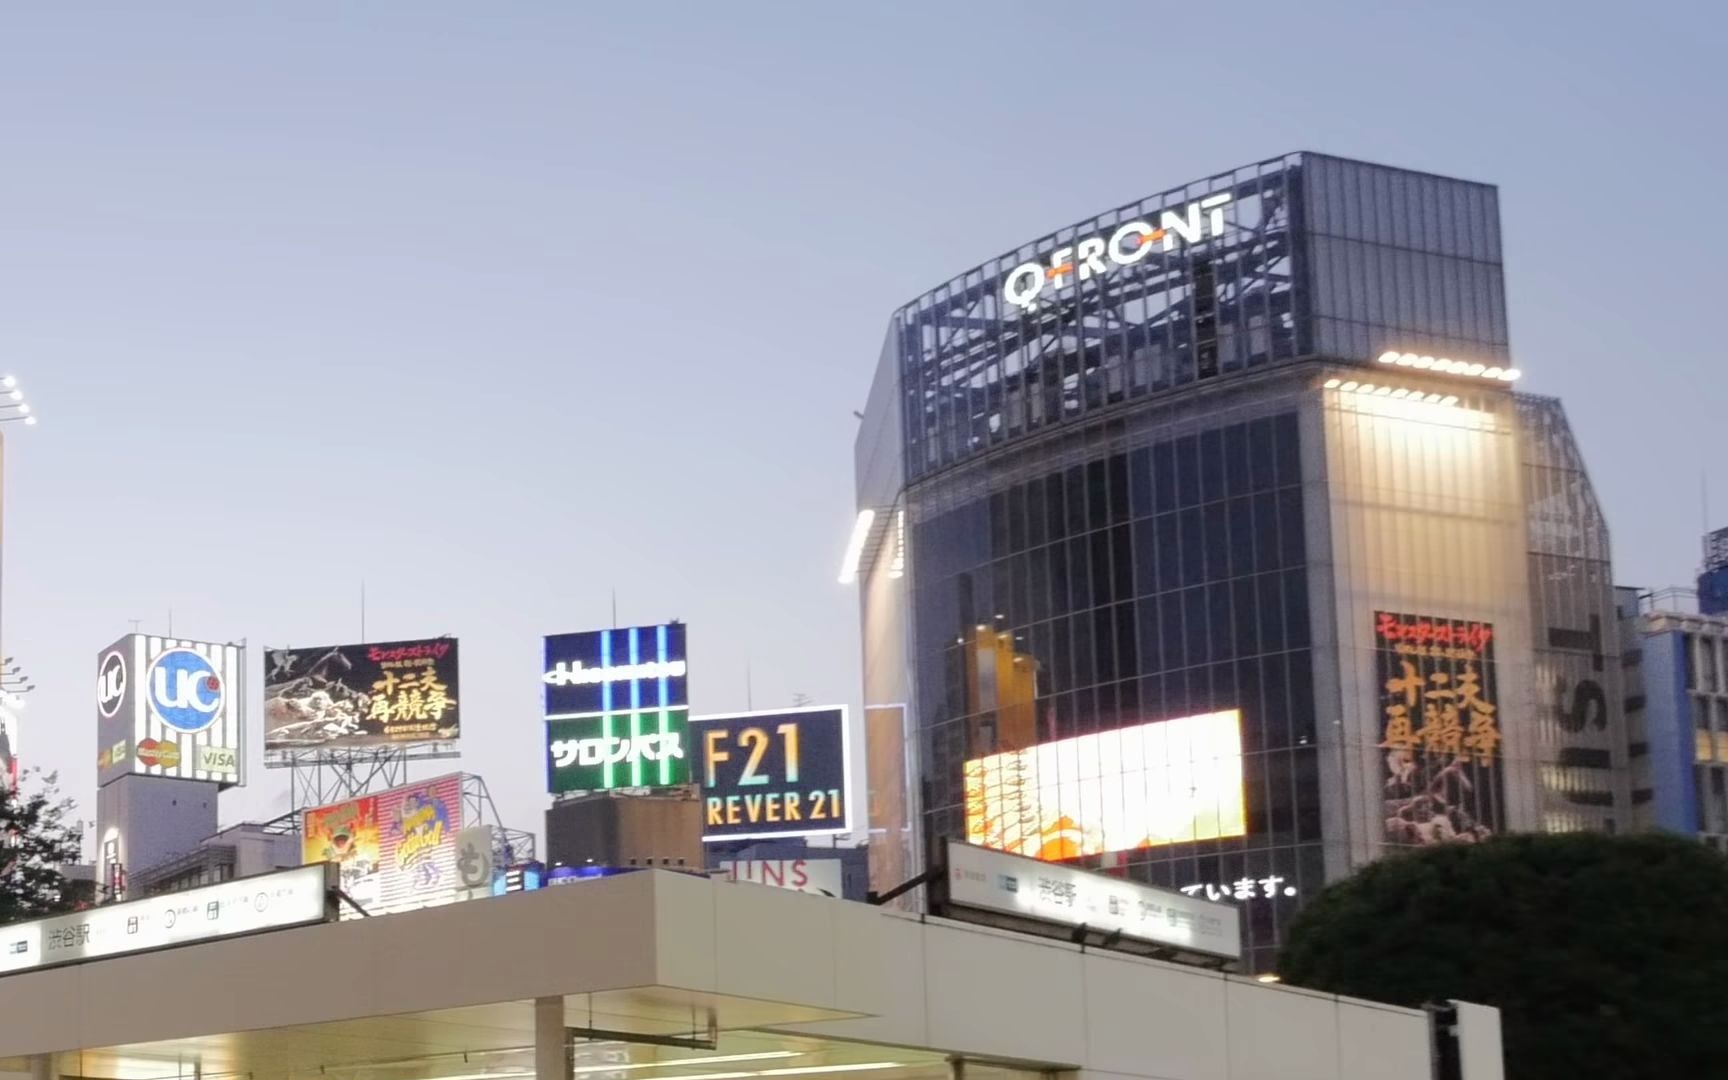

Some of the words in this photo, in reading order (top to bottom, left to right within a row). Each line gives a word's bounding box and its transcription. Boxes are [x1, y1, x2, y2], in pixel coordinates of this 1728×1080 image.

[1004, 193, 1232, 312] QFRONT
[203, 753, 236, 767] VISA
[705, 723, 800, 788] F21
[808, 789, 841, 820] 21
[47, 924, 90, 951] 渋谷駅
